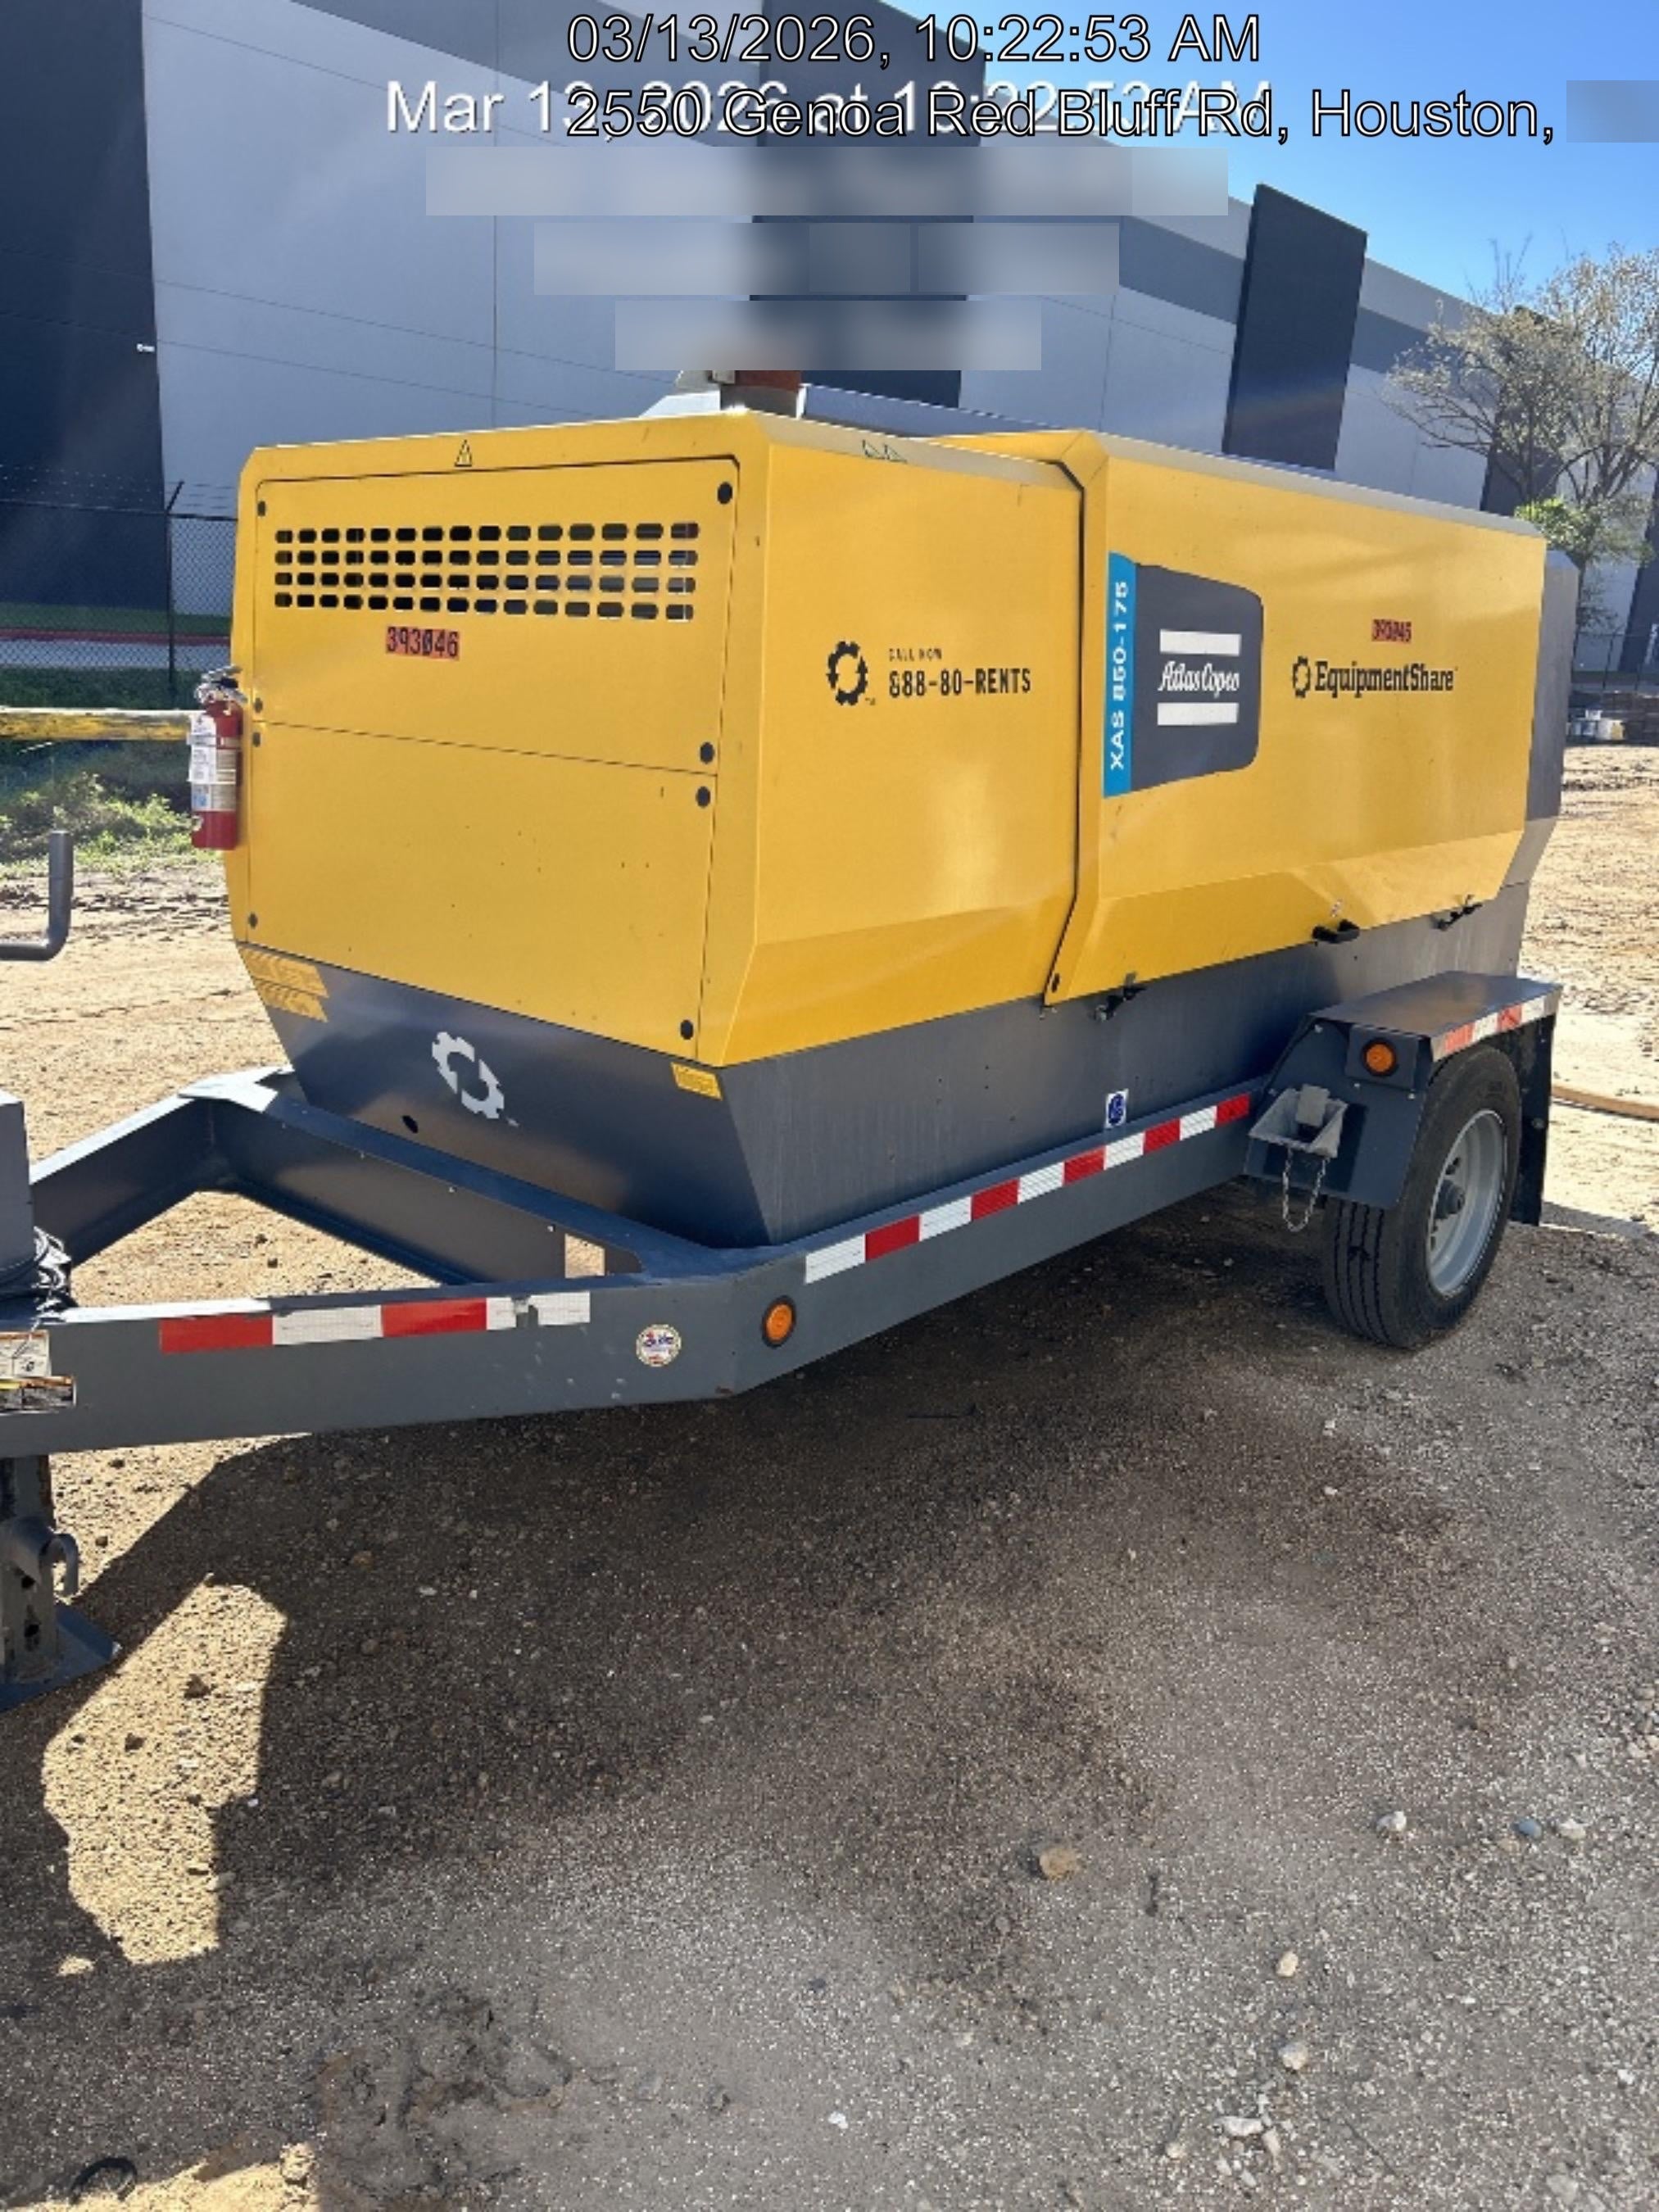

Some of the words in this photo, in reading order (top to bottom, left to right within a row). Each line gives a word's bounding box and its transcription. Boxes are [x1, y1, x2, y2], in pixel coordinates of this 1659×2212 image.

[387, 626, 459, 658] 393046
[889, 669, 1031, 697] 888-80-RENTS
[1157, 660, 1201, 692] Atlas
[1201, 662, 1240, 699] Copco
[1314, 660, 1454, 698] EquipmentShare
[1110, 709, 1125, 770] XAS
